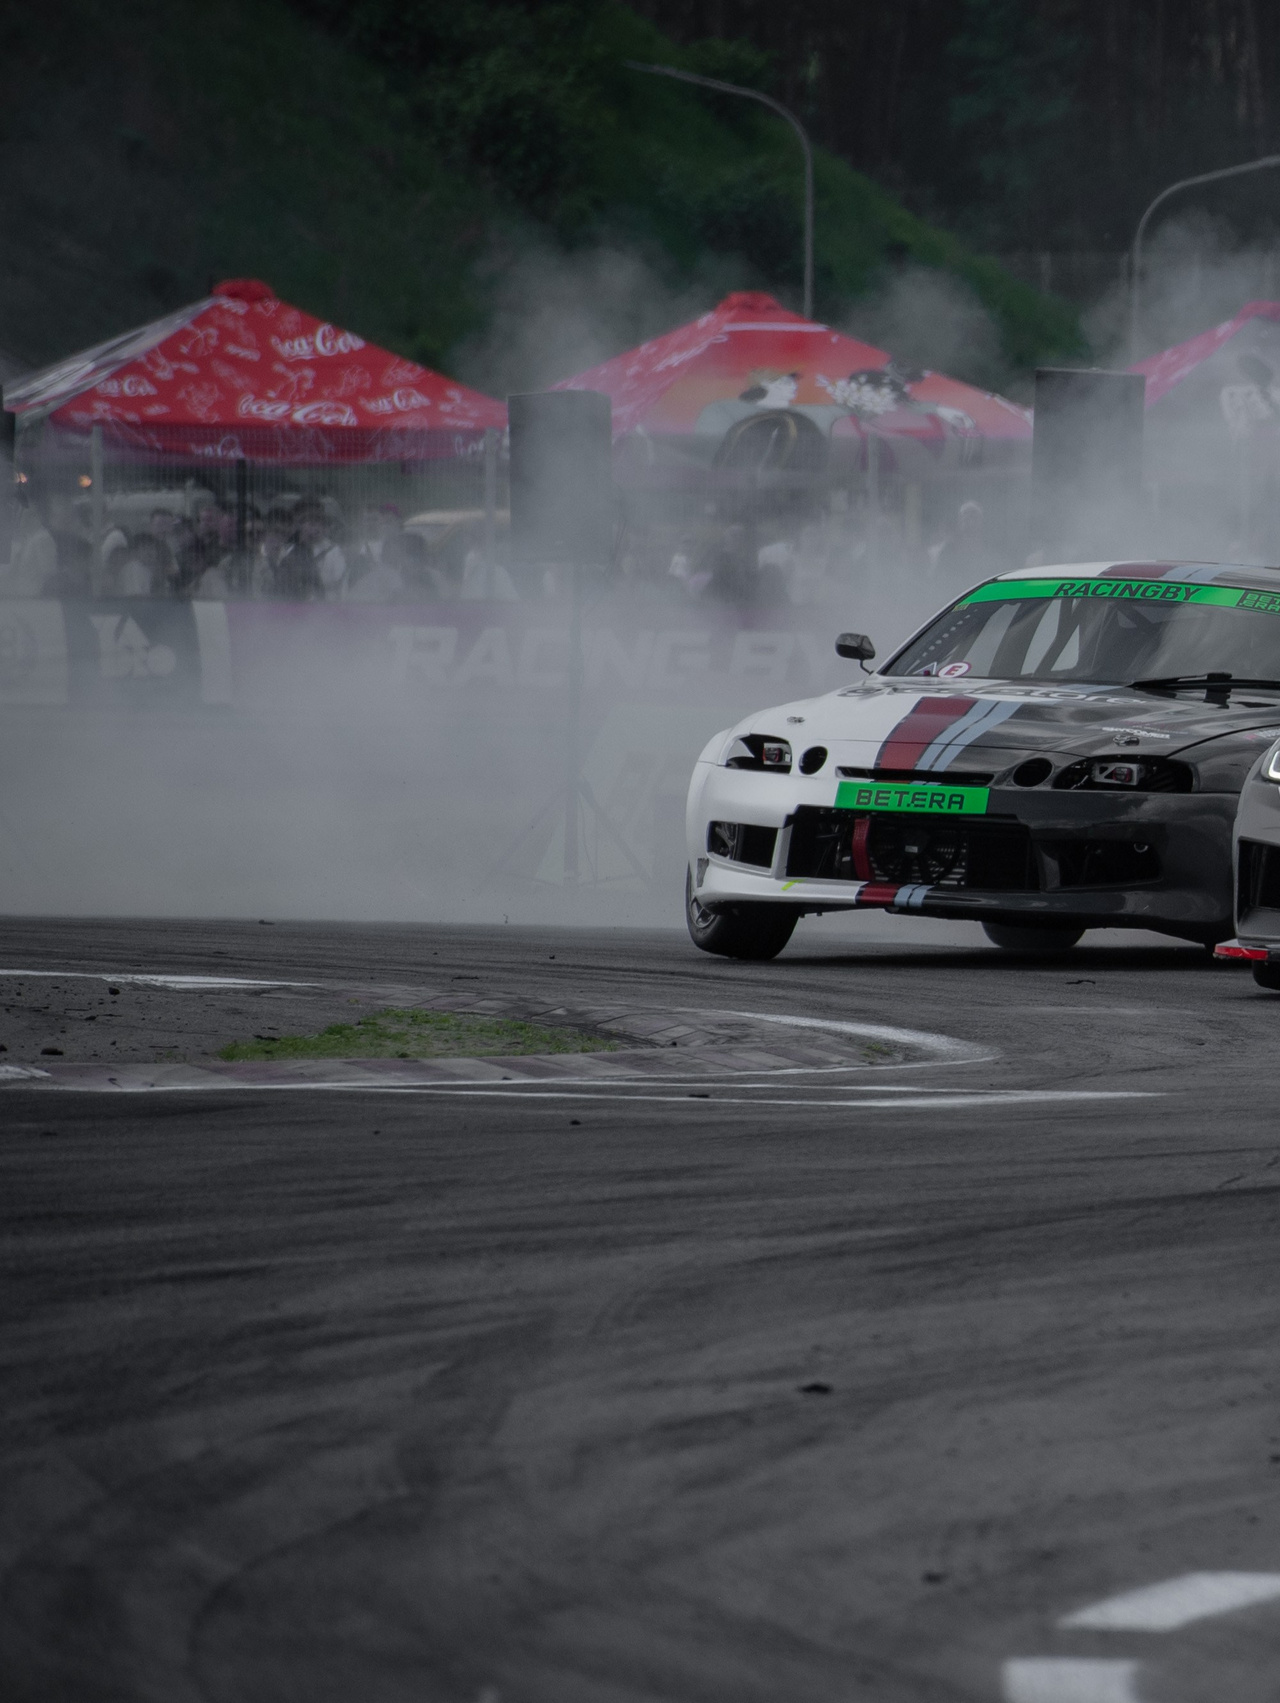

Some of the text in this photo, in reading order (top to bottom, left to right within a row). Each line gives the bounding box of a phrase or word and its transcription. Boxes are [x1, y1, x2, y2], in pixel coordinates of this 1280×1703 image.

[1054, 582, 1202, 602] RACINGBY
[943, 665, 963, 676] E
[856, 788, 965, 810] BET.ERA
